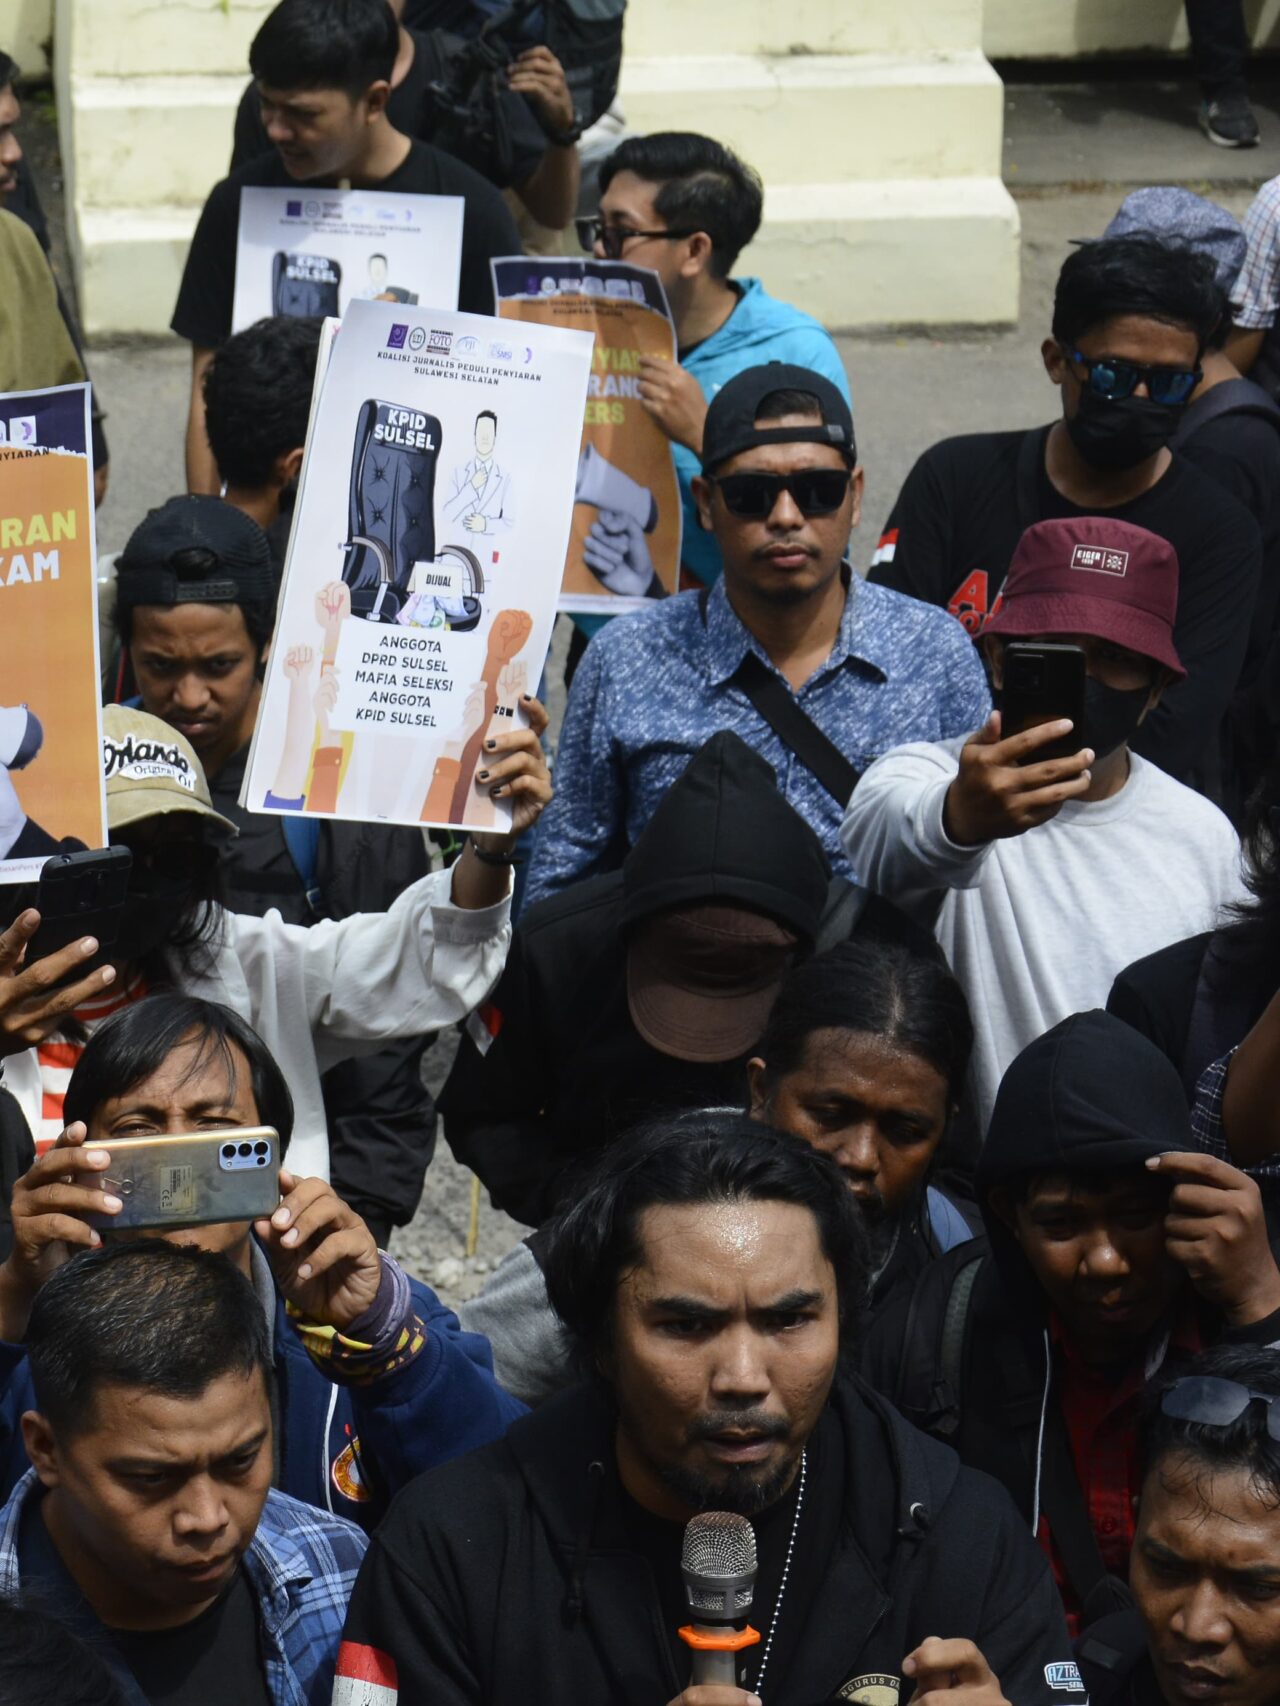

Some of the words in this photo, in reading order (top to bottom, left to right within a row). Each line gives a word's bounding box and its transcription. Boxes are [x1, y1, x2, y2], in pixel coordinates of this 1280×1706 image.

[296, 256, 329, 269] KPID
[286, 266, 337, 283] SULSEL
[429, 334, 452, 346] FOTO
[377, 351, 410, 363] KOALISI
[413, 357, 455, 369] JURNALIS
[458, 363, 489, 374] PEDULI
[492, 368, 542, 382] PENYIARAN
[414, 367, 458, 380] SULAWESI
[461, 374, 499, 385] SELATAN
[388, 409, 426, 430] KPID
[586, 401, 625, 425] ERS
[374, 424, 435, 450] SULSEL
[1077, 550, 1100, 560] EIGER
[426, 574, 451, 587] DIJUAL
[380, 636, 442, 653] ANGGOTA
[362, 652, 397, 666] DPRD
[401, 657, 448, 672] SULSEL
[355, 670, 397, 686] MAFIA
[402, 675, 453, 692] SELEKSI
[369, 691, 431, 708] ANGGOTA
[356, 708, 385, 722] KPID
[390, 712, 437, 727] SULSEL
[134, 766, 175, 774] Original
[841, 1677, 885, 1697] NGURUS
